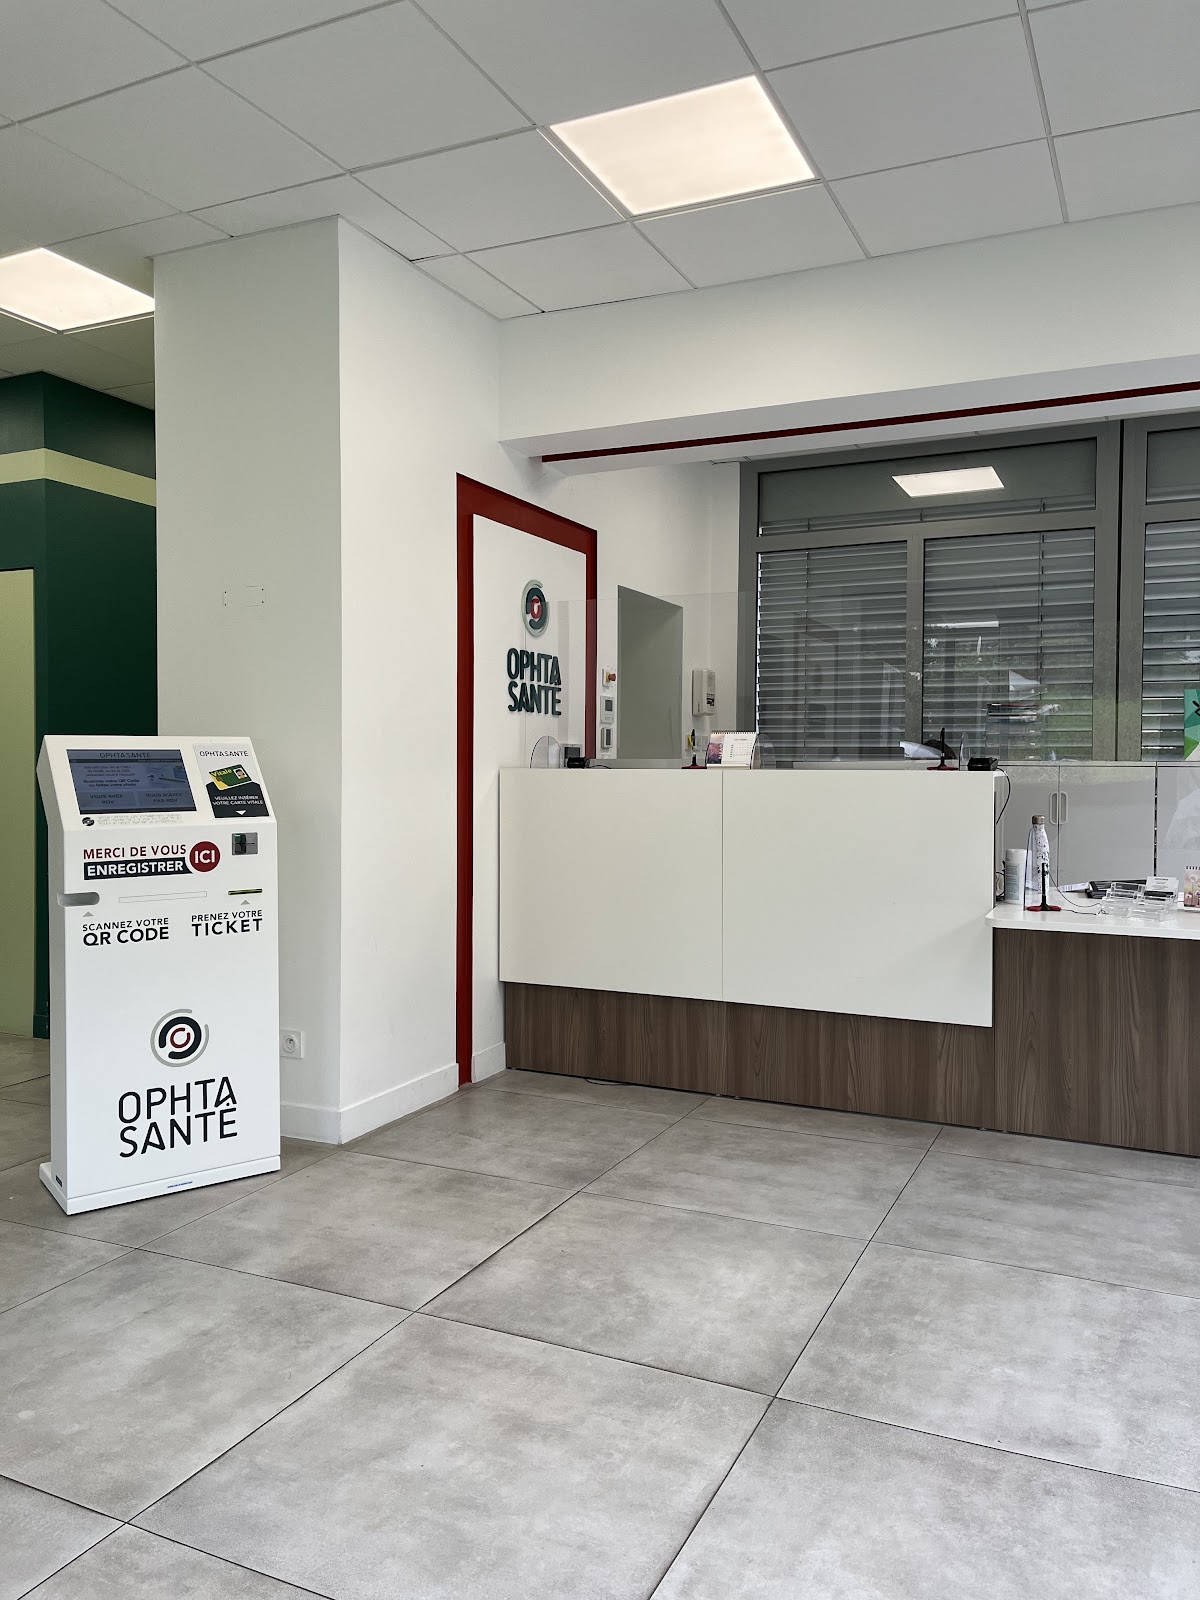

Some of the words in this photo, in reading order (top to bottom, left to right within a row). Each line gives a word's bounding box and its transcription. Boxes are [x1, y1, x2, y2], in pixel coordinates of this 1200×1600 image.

[507, 648, 561, 685] OPHTA
[211, 769, 232, 777] Vitale
[83, 847, 125, 859] MERCI
[130, 846, 147, 857] DE
[151, 845, 186, 855] VOUS
[195, 850, 215, 864] ICI
[87, 861, 183, 877] ENREGISTRER
[192, 912, 229, 922] PRENEZ
[232, 910, 262, 919] VOTRE
[82, 920, 132, 931] SCANNEZ
[136, 918, 169, 927] VOTRE
[192, 918, 263, 937] TICKET
[83, 932, 111, 947] QR
[117, 927, 169, 943] CODE
[118, 1076, 237, 1124] OPHTA
